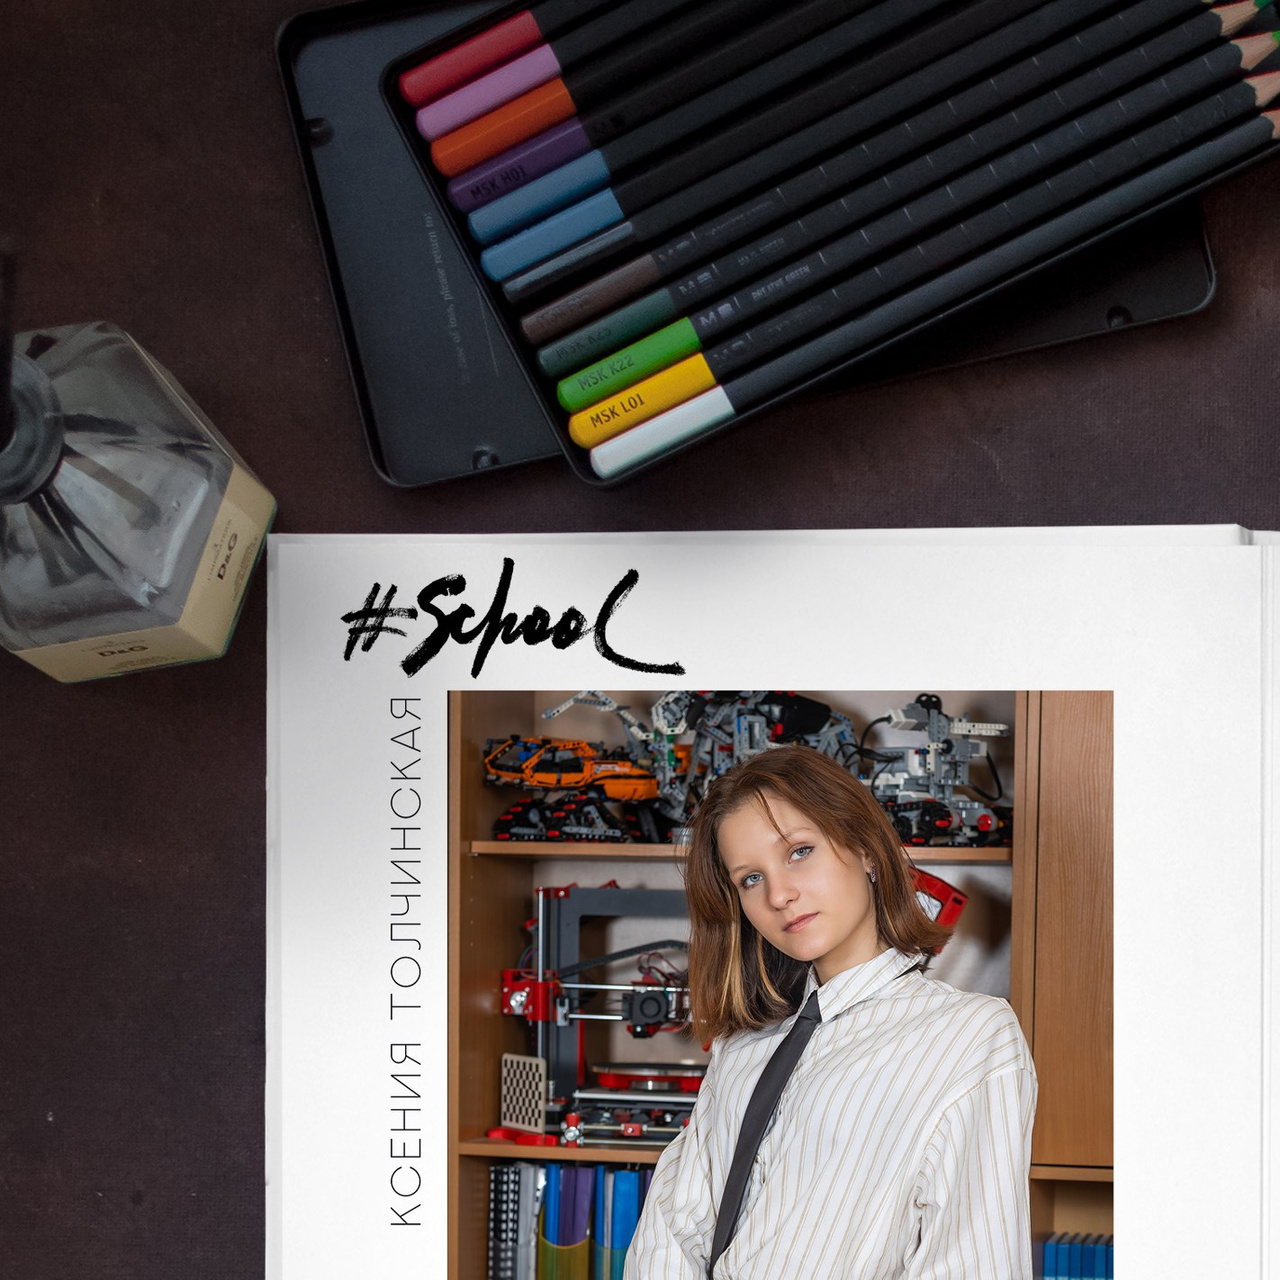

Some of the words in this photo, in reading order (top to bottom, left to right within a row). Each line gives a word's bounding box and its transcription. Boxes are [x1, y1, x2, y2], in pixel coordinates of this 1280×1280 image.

[428, 230, 444, 265] return
[437, 267, 455, 302] please
[577, 368, 609, 391] MSK
[608, 354, 635, 376] K22
[589, 404, 621, 429] MSK
[620, 392, 646, 414] L01
[217, 532, 239, 581] D&G
[390, 697, 422, 1021] ТОЛЧИНСКАЯ
[390, 1043, 422, 1227] КСЕНИЯ
